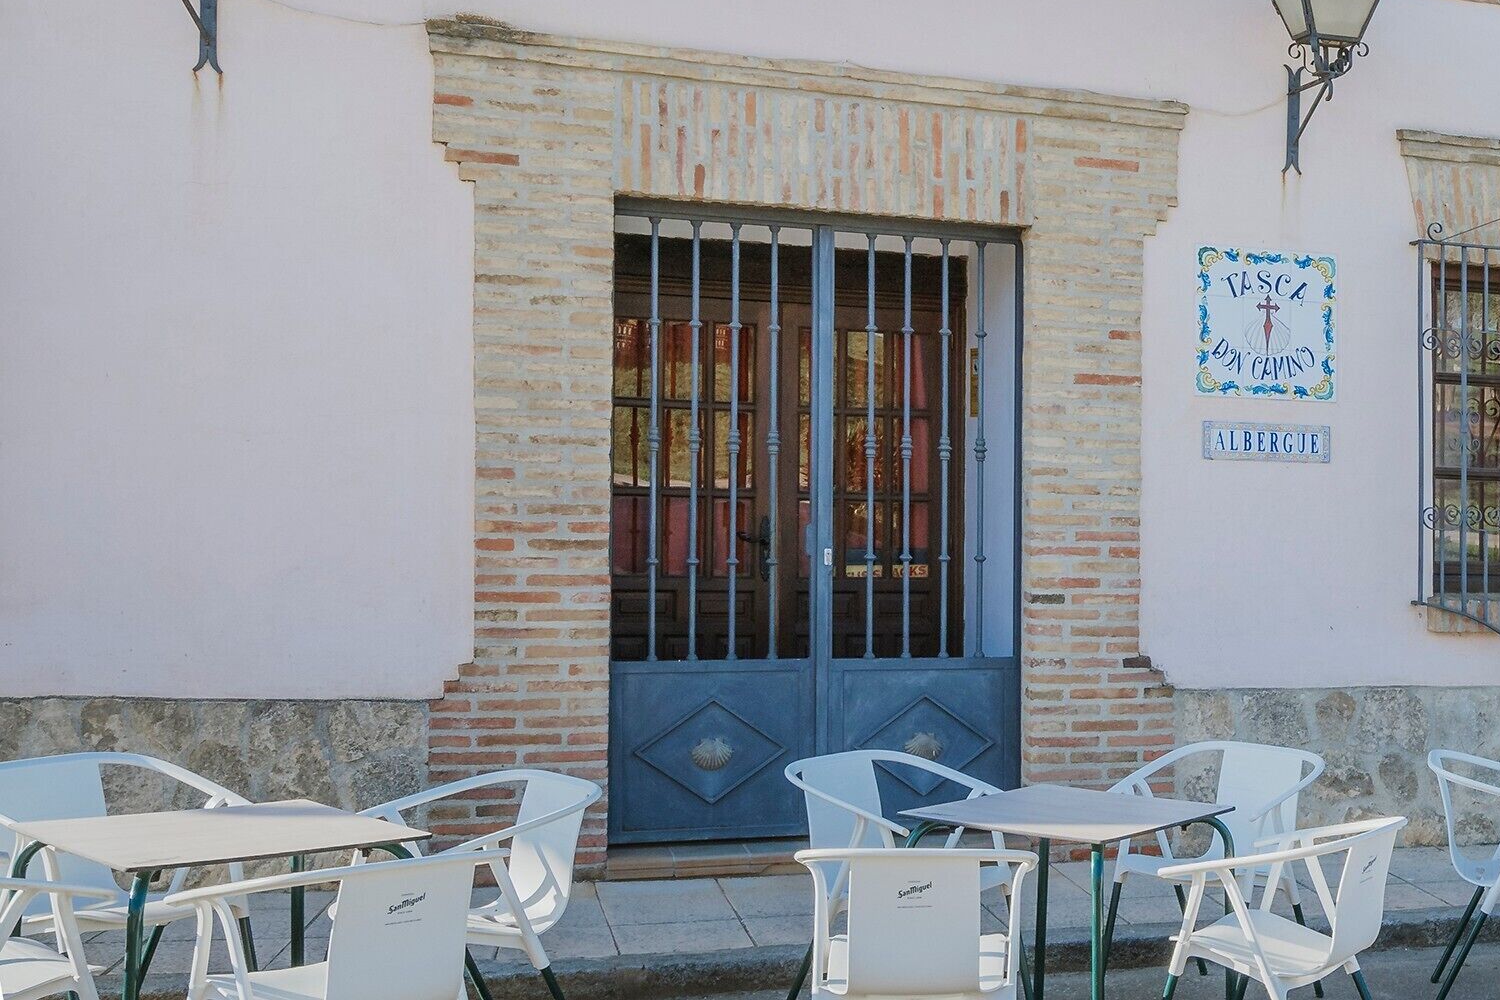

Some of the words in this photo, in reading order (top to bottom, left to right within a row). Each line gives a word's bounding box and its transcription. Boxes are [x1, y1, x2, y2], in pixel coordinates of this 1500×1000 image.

[1221, 270, 1307, 307] TASCA
[1211, 338, 1250, 374] DON
[1252, 346, 1315, 380] CAMINO
[1215, 431, 1319, 454] ALBERGUE
